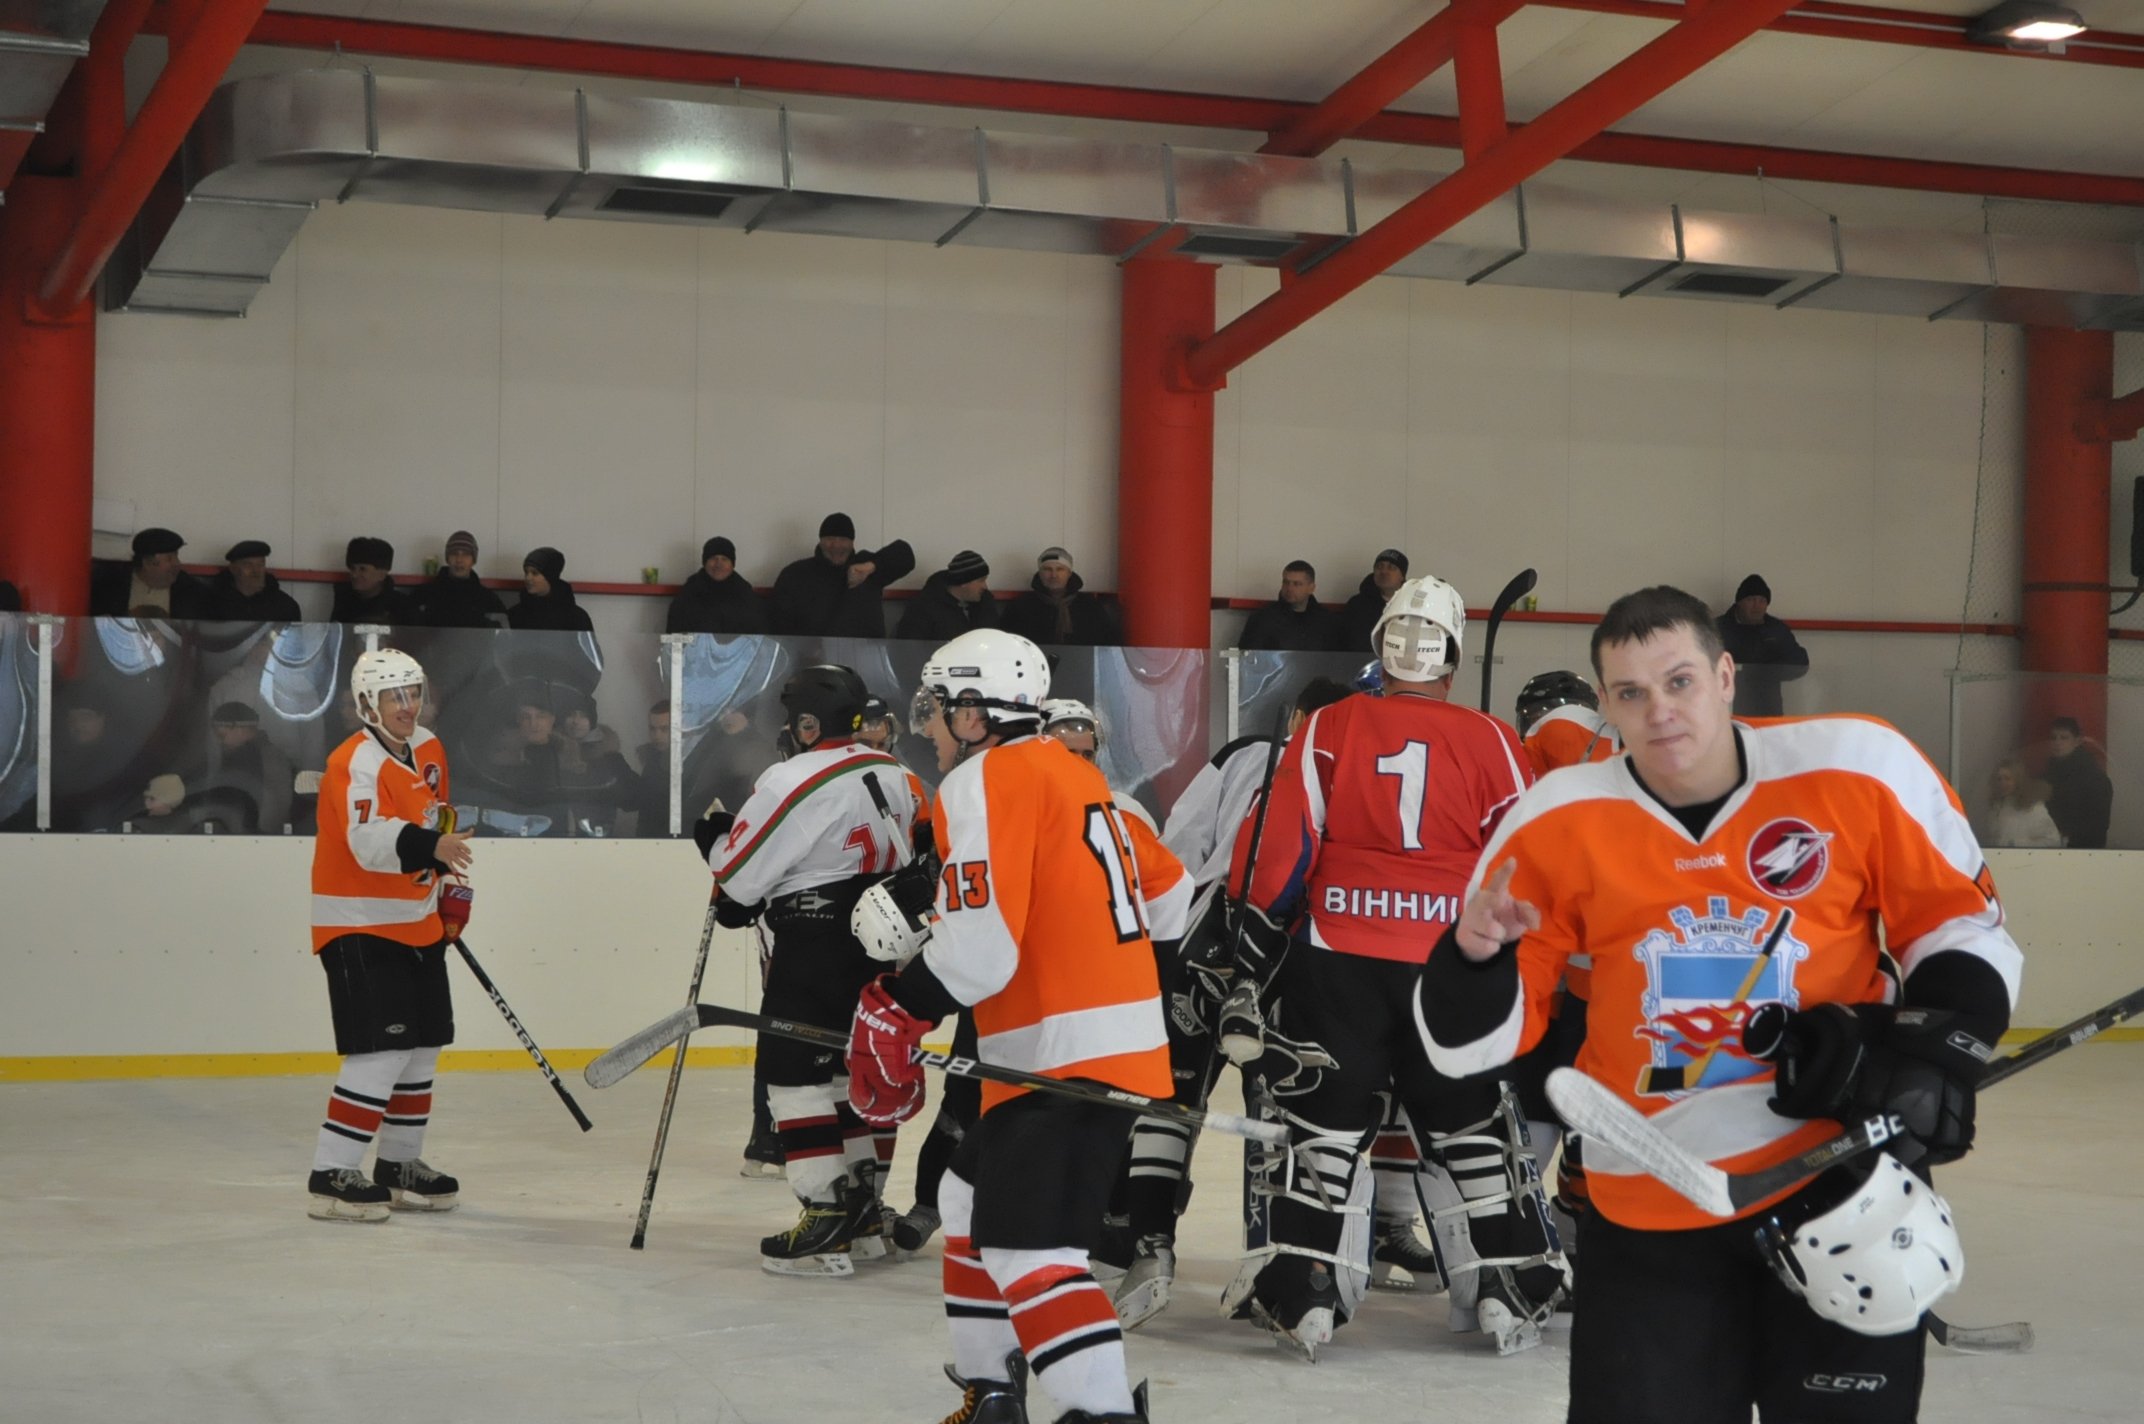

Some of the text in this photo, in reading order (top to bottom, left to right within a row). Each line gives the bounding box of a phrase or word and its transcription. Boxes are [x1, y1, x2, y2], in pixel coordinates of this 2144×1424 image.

[1375, 738, 1429, 852] 1
[354, 799, 372, 824] 7
[1674, 853, 1727, 872] Reebok
[942, 860, 989, 913] 13
[1690, 920, 1748, 937] КРЕМЕНЧУГ
[1106, 1090, 1151, 1106] BAUER
[1831, 1136, 1855, 1156] ONE
[1811, 1373, 1879, 1392] CCM
